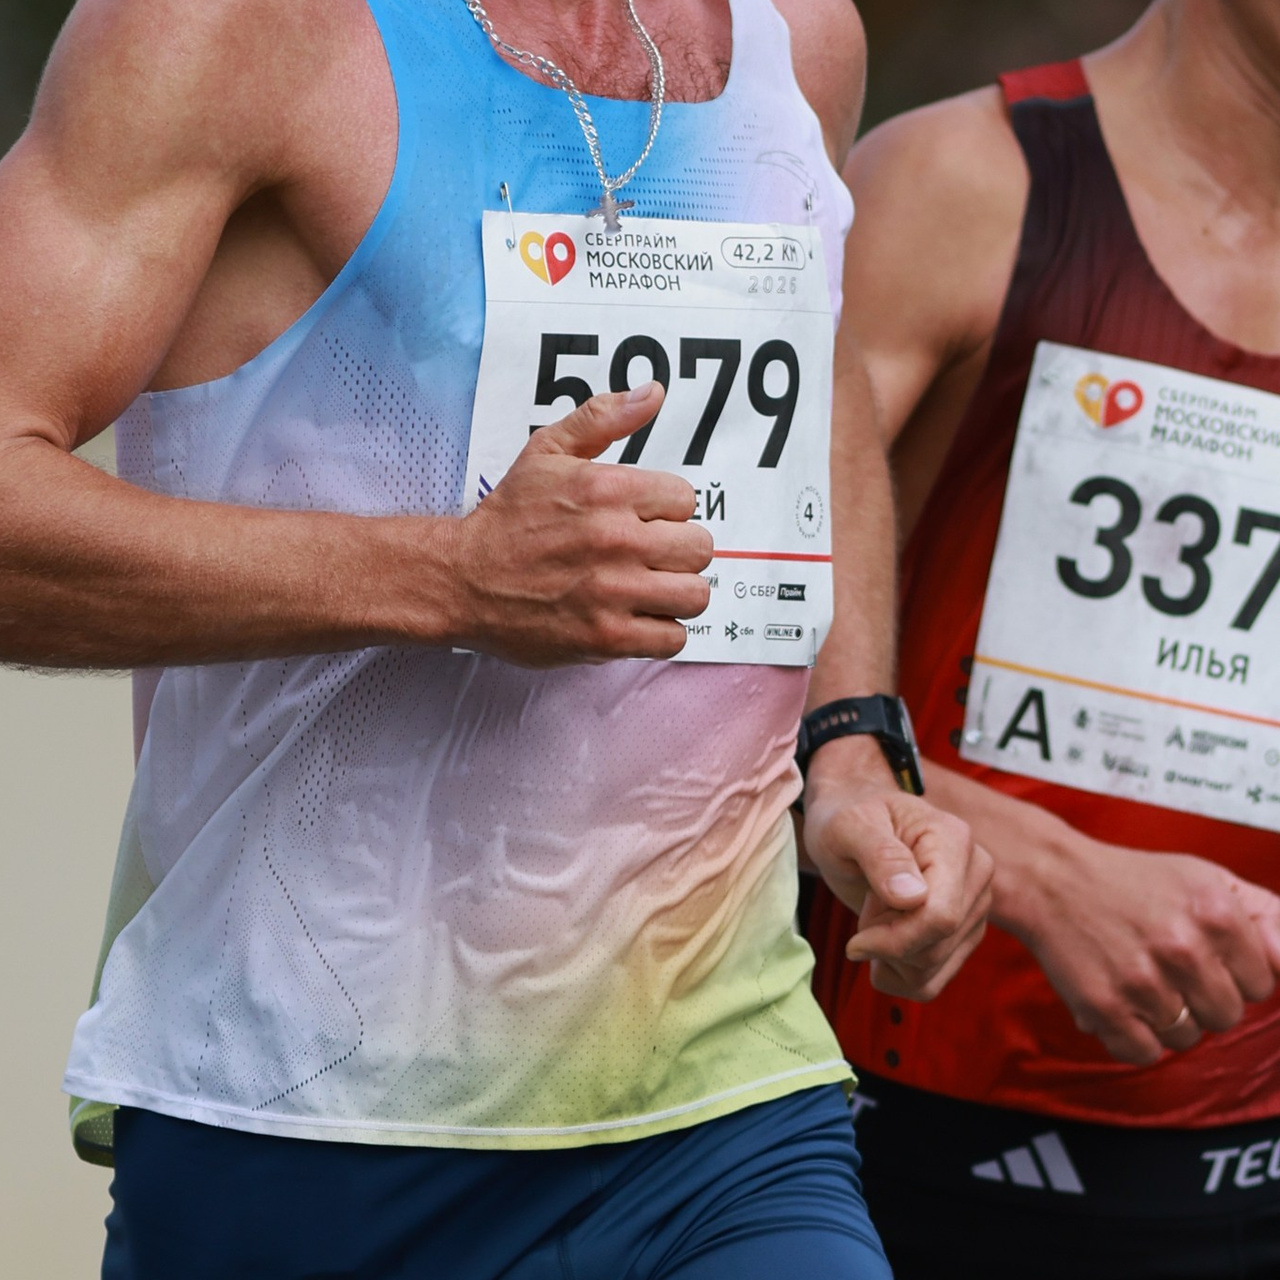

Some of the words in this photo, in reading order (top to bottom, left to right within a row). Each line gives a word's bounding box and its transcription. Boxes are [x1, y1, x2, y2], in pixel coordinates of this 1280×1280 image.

[585, 232, 677, 249] СБЕРПРАЙМ
[586, 250, 713, 271] МОСКОВСКИЙ
[733, 243, 774, 263] 42,2
[589, 271, 681, 291] МАРАФОН
[528, 332, 801, 469] 5979
[1154, 403, 1280, 448] МОСКОВСКИ
[1150, 423, 1254, 462] МАРАФОН
[804, 502, 814, 522] 4
[750, 585, 776, 597] СБЕР
[1155, 637, 1251, 685] ИЛЬЯ
[995, 687, 1052, 762] A
